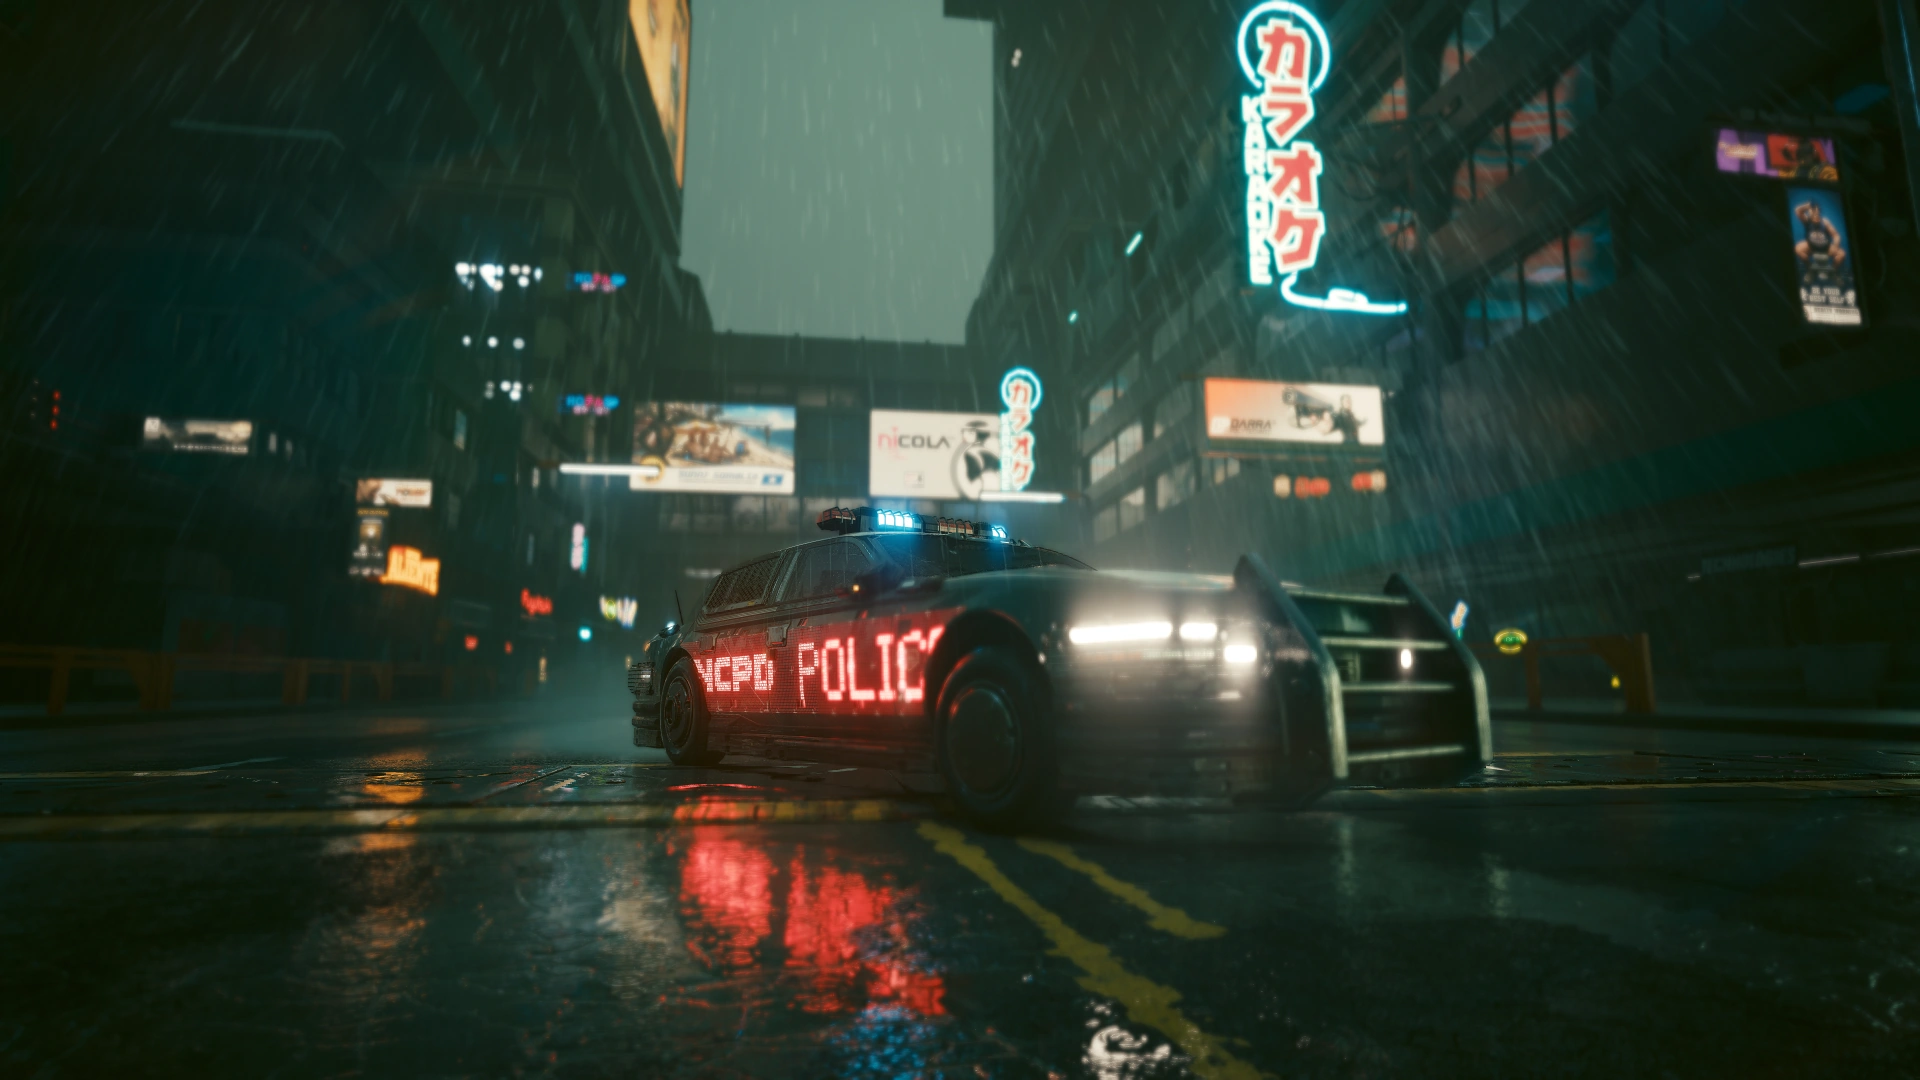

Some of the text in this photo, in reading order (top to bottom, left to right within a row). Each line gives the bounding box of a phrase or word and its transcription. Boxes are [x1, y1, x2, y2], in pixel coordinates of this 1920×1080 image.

[1242, 95, 1273, 285] KARAOKE
[1256, 18, 1325, 274] カラオケ
[1008, 379, 1034, 491] カラオケ
